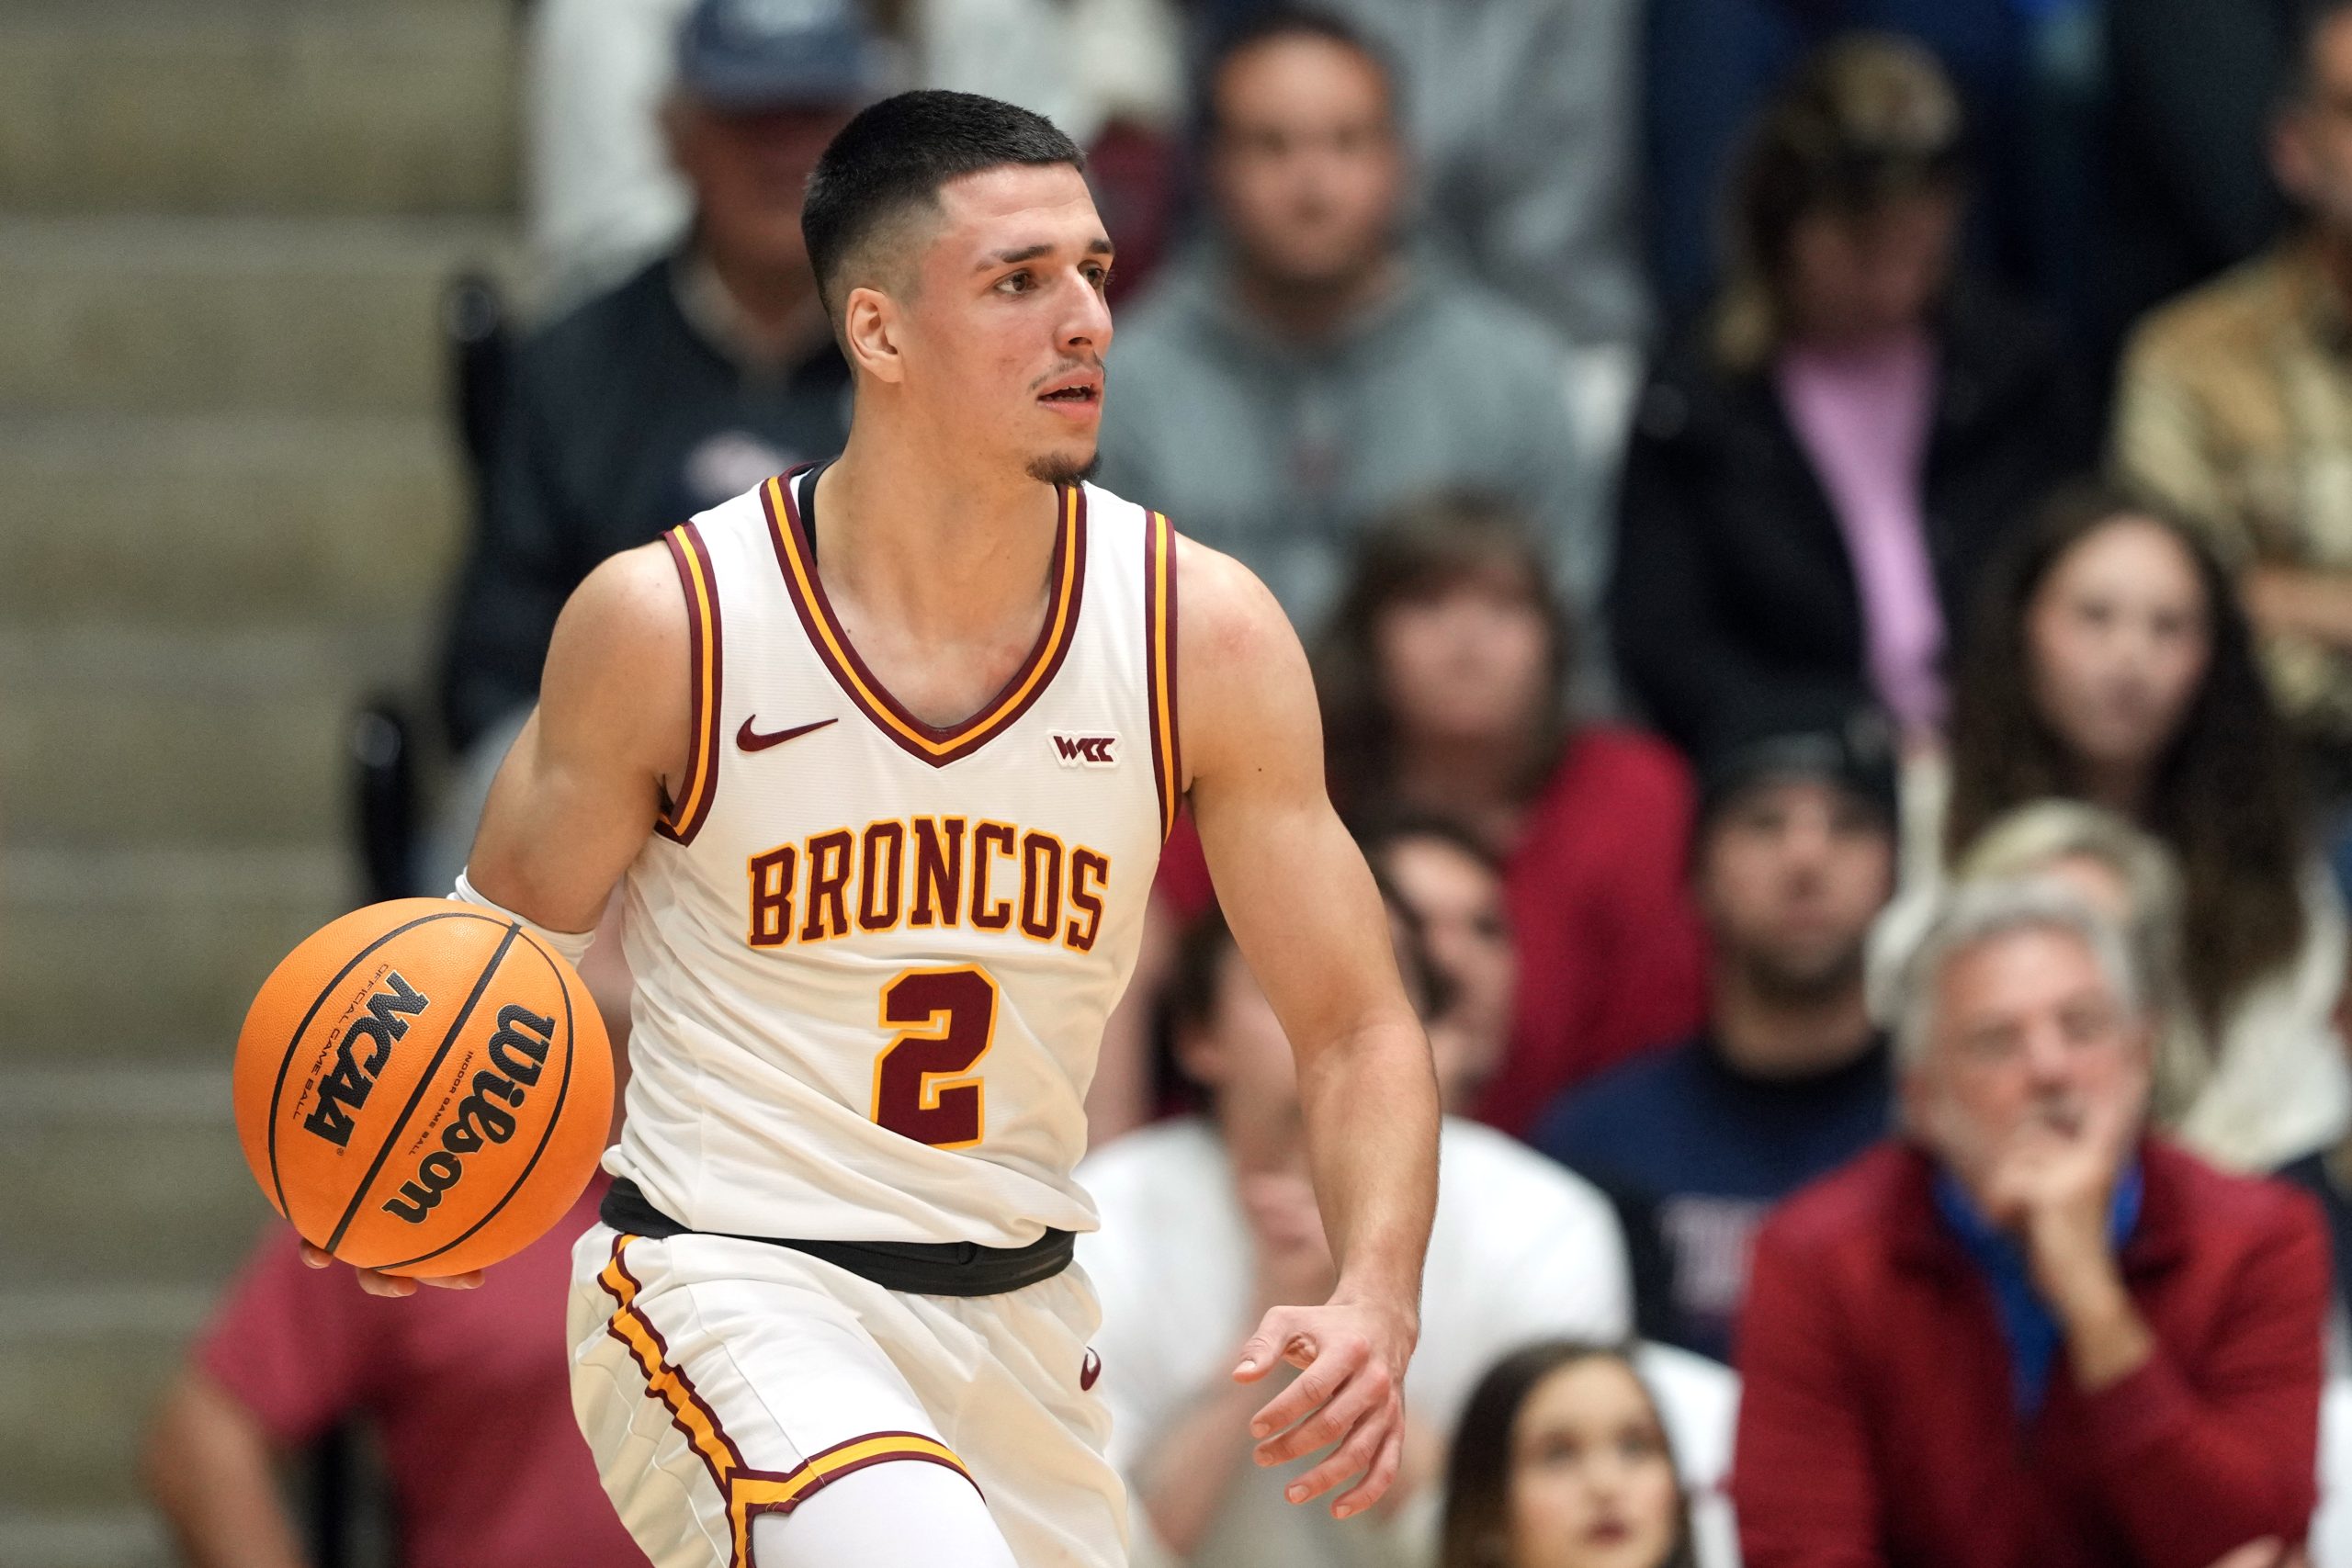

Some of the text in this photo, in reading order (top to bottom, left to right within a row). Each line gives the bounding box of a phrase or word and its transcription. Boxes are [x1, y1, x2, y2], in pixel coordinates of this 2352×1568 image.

[1053, 735, 1115, 762] WCC
[747, 815, 1111, 954] BRONCOS
[293, 964, 389, 1120] OFFICIAL GAME BALL
[303, 970, 430, 1147] NCAA
[380, 1003, 556, 1224] Wilson
[408, 1051, 474, 1156] INDOOR GAME BALL
[870, 963, 999, 1150] 2
